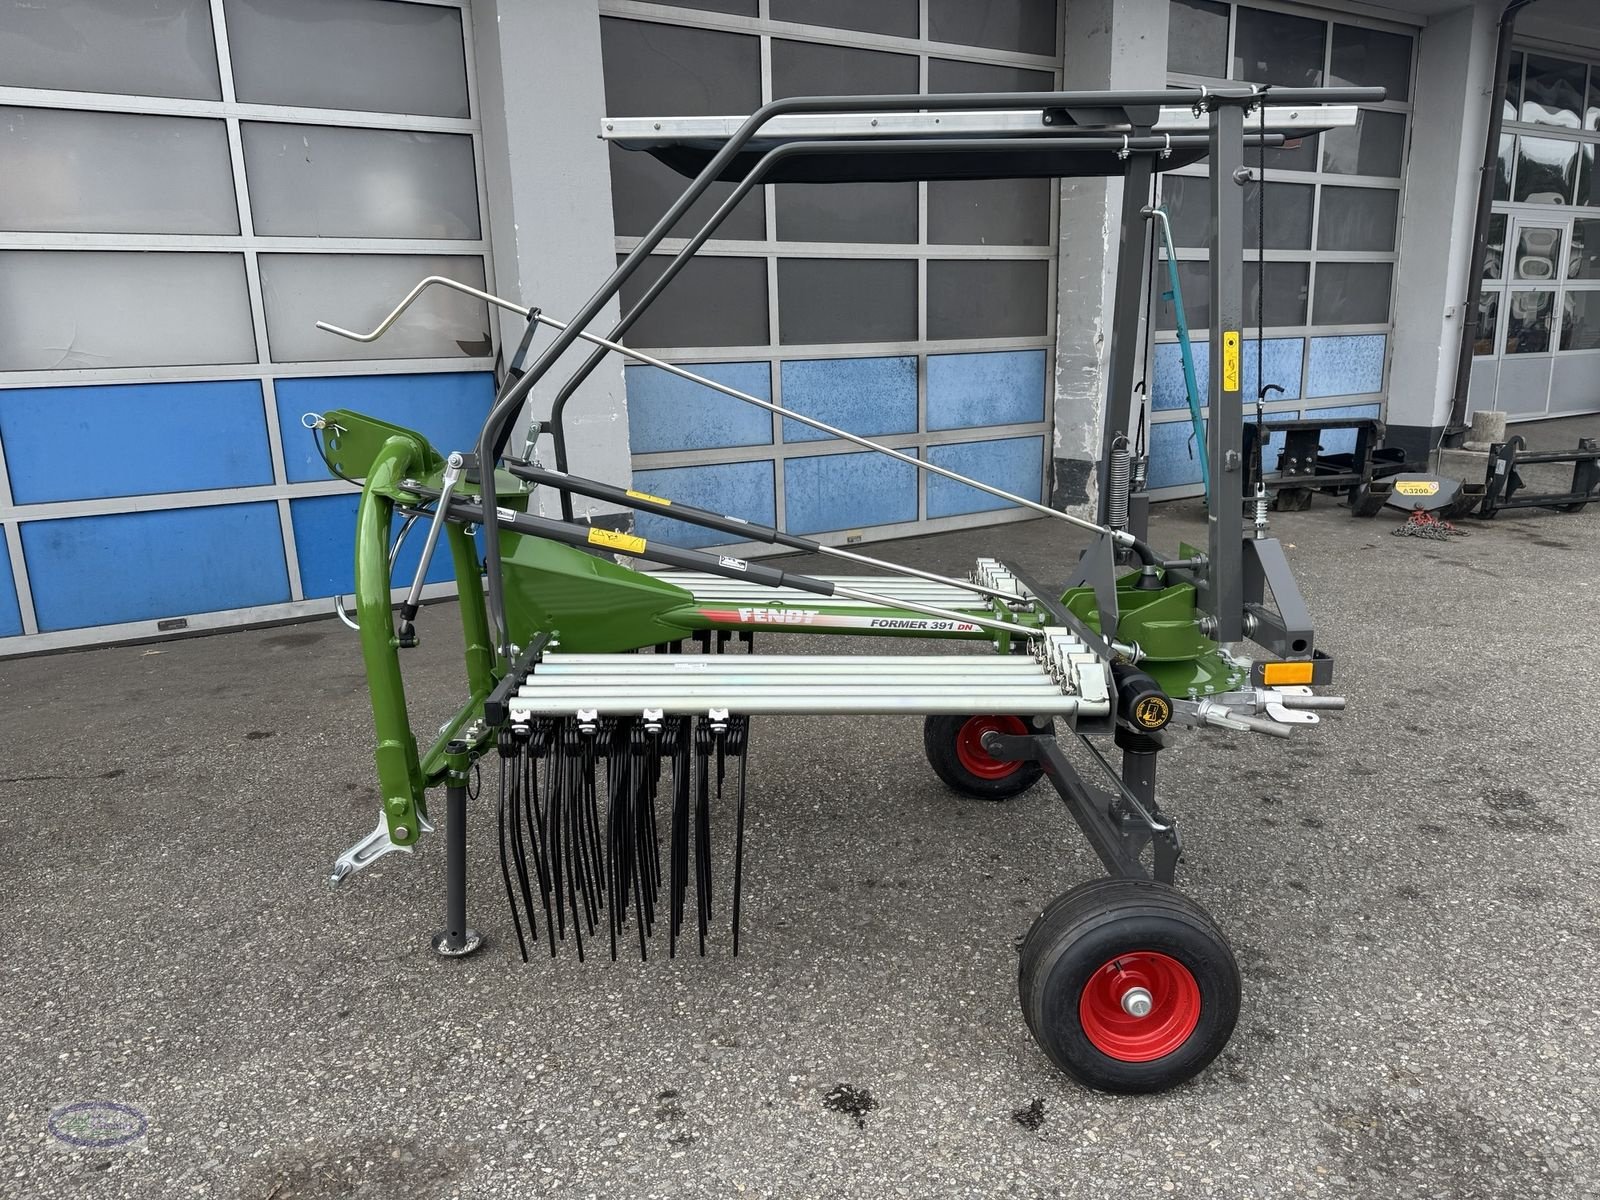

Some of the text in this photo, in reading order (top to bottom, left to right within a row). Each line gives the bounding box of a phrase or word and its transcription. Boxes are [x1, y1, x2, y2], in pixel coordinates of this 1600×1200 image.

[738, 608, 819, 623] FENDT
[870, 619, 973, 631] FORMER 391 DN
